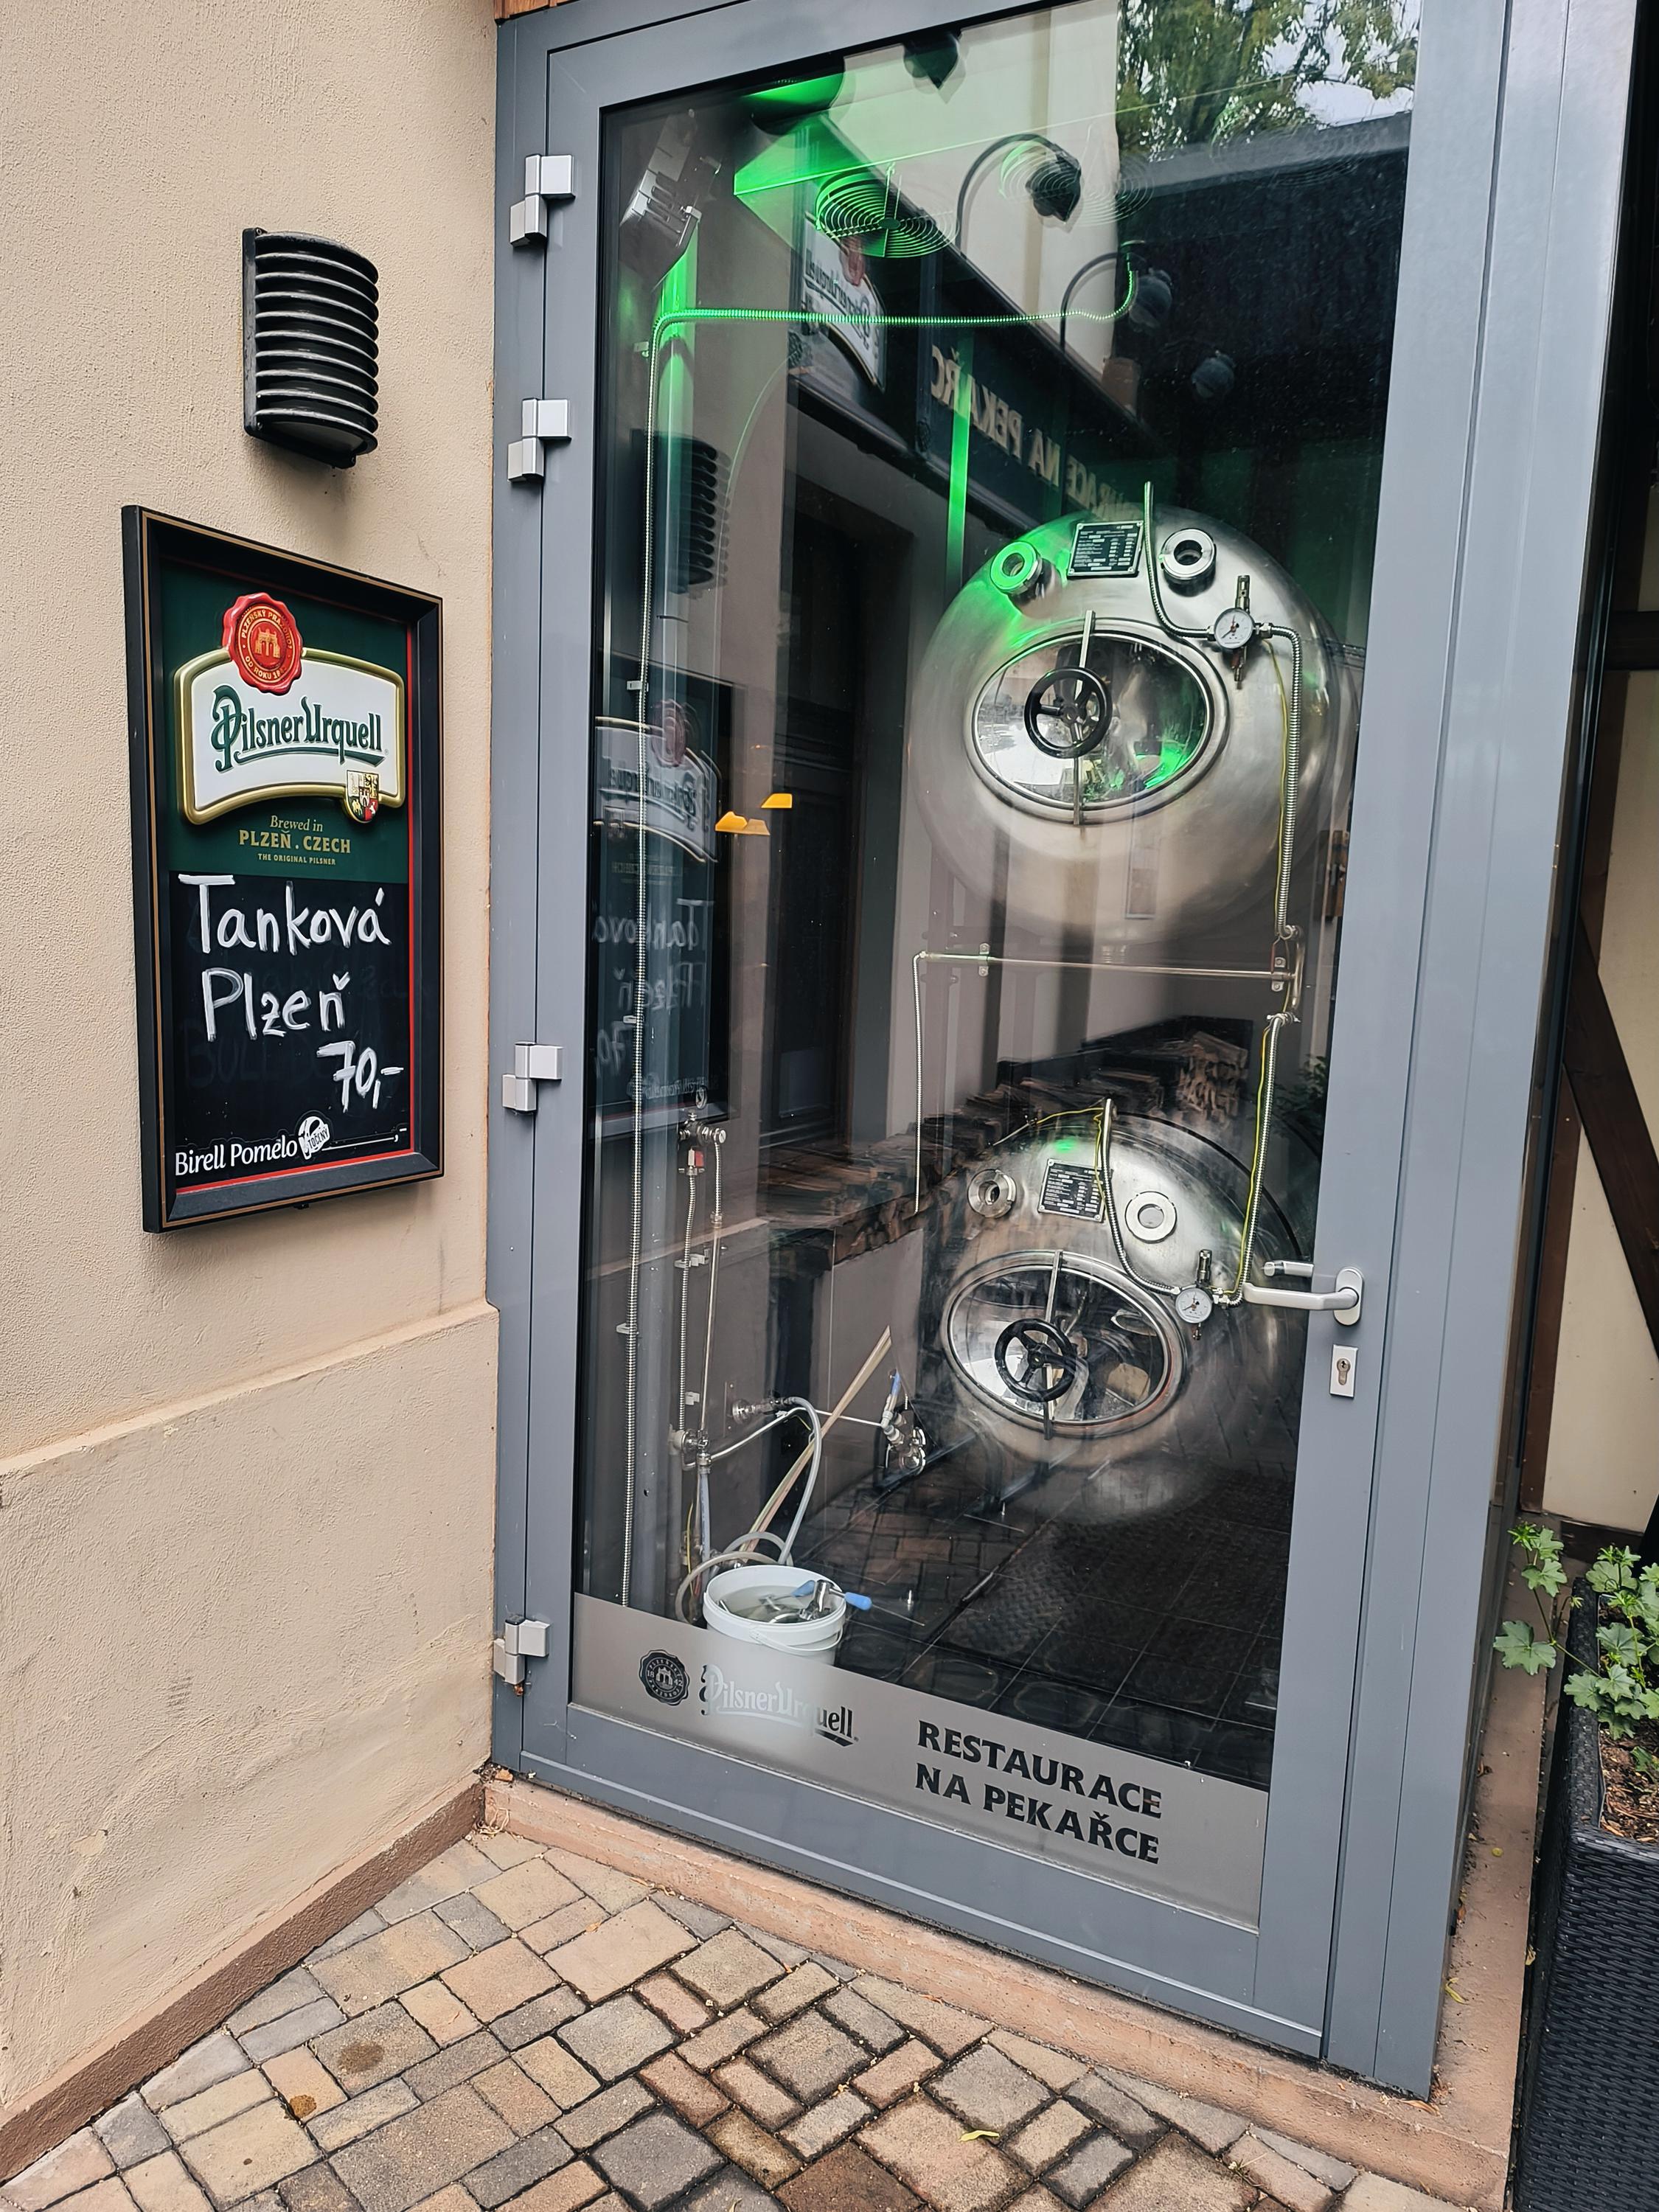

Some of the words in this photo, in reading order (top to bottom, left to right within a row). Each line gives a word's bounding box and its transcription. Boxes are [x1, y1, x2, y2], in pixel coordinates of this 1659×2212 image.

[245, 655, 254, 668] OD
[253, 666, 272, 679] ROKU
[211, 684, 304, 773] Pilsner
[301, 696, 383, 765] Urquell
[239, 830, 291, 849] PLZEŇ
[303, 835, 351, 853] CZECH
[270, 815, 310, 831] Brewed
[313, 819, 323, 832] in
[274, 854, 307, 863] ORIGINAL
[309, 857, 336, 866] PILSNER
[178, 874, 392, 956] Tanková
[201, 967, 351, 1042] Plzeň
[175, 1144, 226, 1176] Birell
[231, 1135, 298, 1167] Pomelo
[647, 1670, 655, 1678] 18
[699, 1663, 778, 1716] Pilsner
[917, 1719, 1162, 1819] RESTAURACE
[915, 1762, 971, 1805] NA
[983, 1783, 1159, 1864] PEKAŘCE
